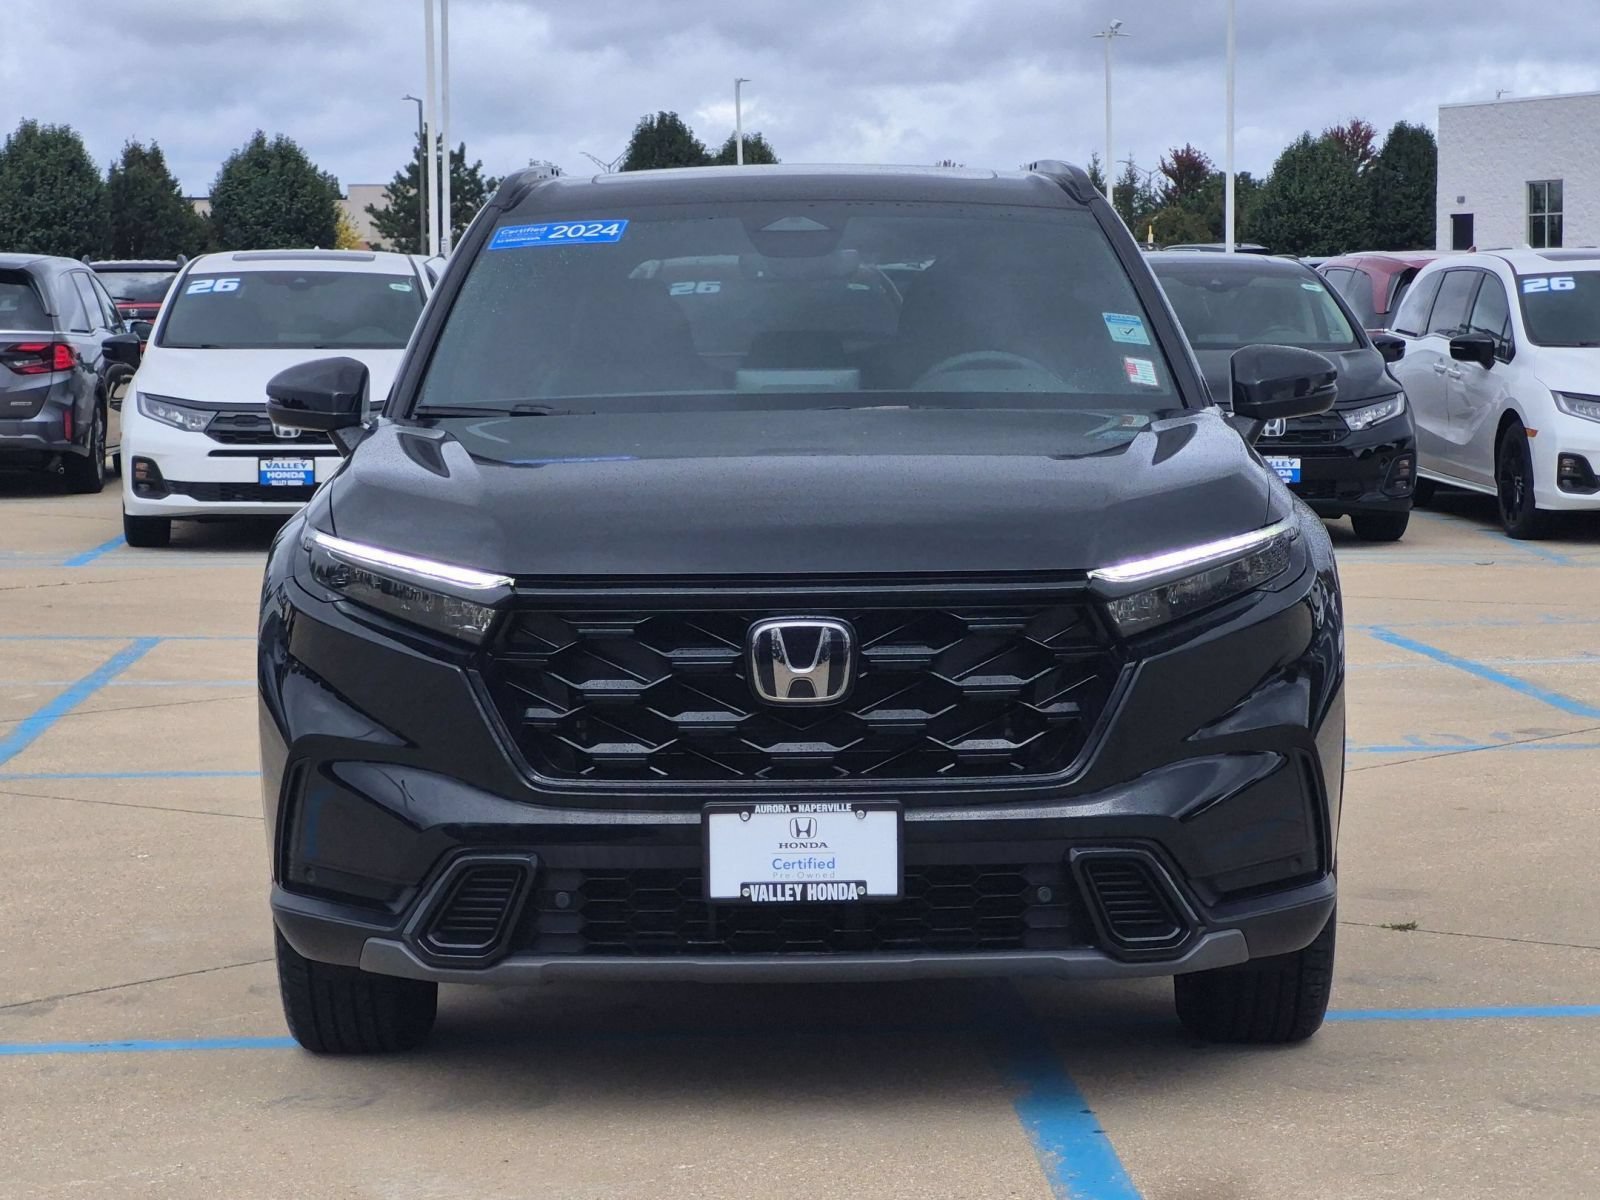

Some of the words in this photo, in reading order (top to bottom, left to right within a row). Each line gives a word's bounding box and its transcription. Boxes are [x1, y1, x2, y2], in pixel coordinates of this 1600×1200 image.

[547, 223, 620, 239] 2024
[184, 278, 241, 294] 26
[669, 281, 721, 296] 26
[1522, 277, 1576, 294] 26
[754, 804, 791, 814] AURORA
[798, 803, 852, 812] NAPERVILLE
[772, 857, 836, 870] Certified
[749, 884, 803, 902] VALLEY
[807, 883, 859, 901] HONDA
